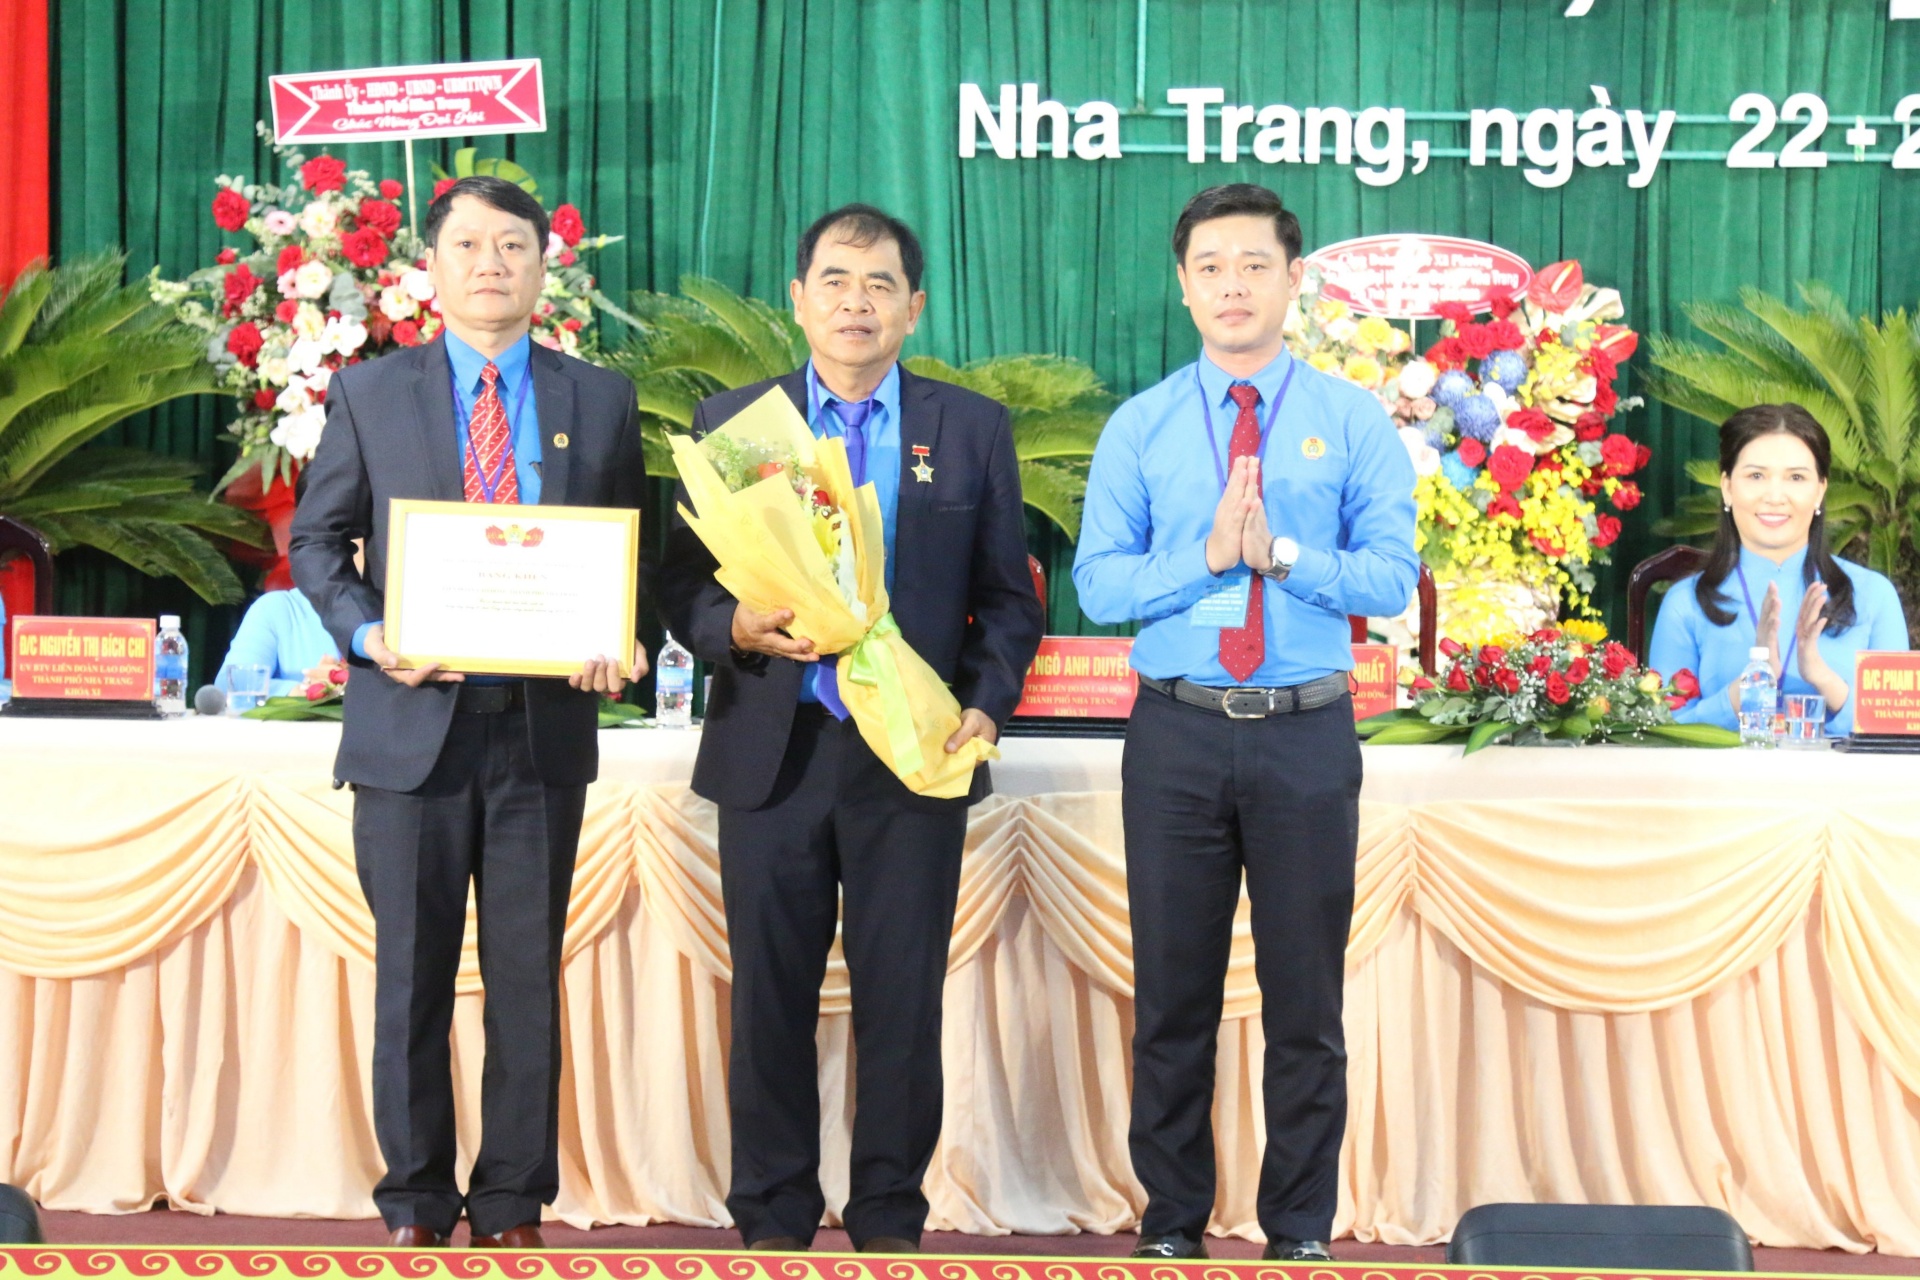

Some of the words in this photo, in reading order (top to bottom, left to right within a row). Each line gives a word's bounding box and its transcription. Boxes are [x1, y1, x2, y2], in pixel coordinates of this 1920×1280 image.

[959, 83, 1122, 160] Nha
[1167, 87, 1429, 186] Trang,
[1469, 85, 1676, 188] ngày
[39, 628, 81, 656] NGUYỄN
[83, 636, 99, 662] THỊ
[101, 633, 126, 658] BÍCH
[128, 637, 146, 658] CHI
[32, 673, 62, 685] THÀNH
[64, 673, 83, 685] PHỐ
[84, 676, 102, 685] NHA
[104, 676, 133, 686] TRANG
[33, 663, 51, 672] BTV
[52, 662, 72, 673] LIÊN
[100, 664, 118, 674] LAO
[119, 663, 144, 675] ĐỘNG
[1035, 651, 1061, 676] NGÔ
[1064, 655, 1090, 676] ANH
[1093, 652, 1130, 681] DUYỆT
[1353, 655, 1385, 683] NHẤT
[1883, 669, 1914, 695] PHẠM
